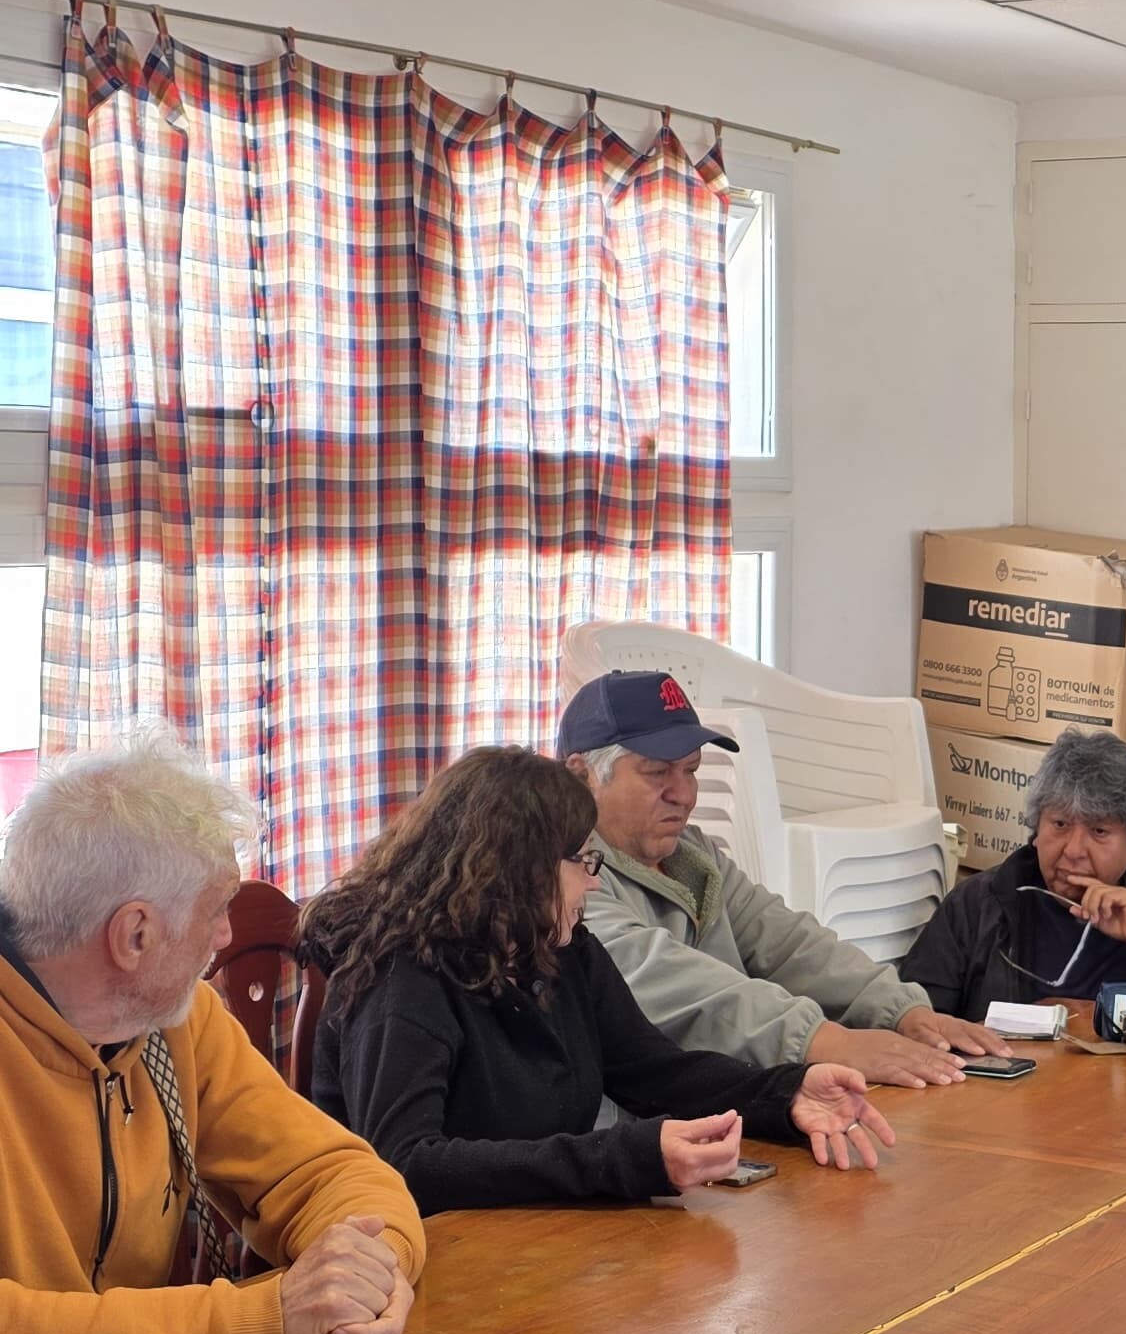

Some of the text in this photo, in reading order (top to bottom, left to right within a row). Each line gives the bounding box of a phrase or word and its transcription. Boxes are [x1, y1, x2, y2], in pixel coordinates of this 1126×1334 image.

[968, 599, 1071, 630] remediar
[923, 660, 982, 677] 0800 666 3300
[1046, 678, 1115, 696] BOTIQUÍN de
[1046, 692, 1115, 709] medicamentos
[945, 795, 968, 816] Virrey
[969, 800, 992, 820] Liniers
[995, 806, 1011, 822] 667
